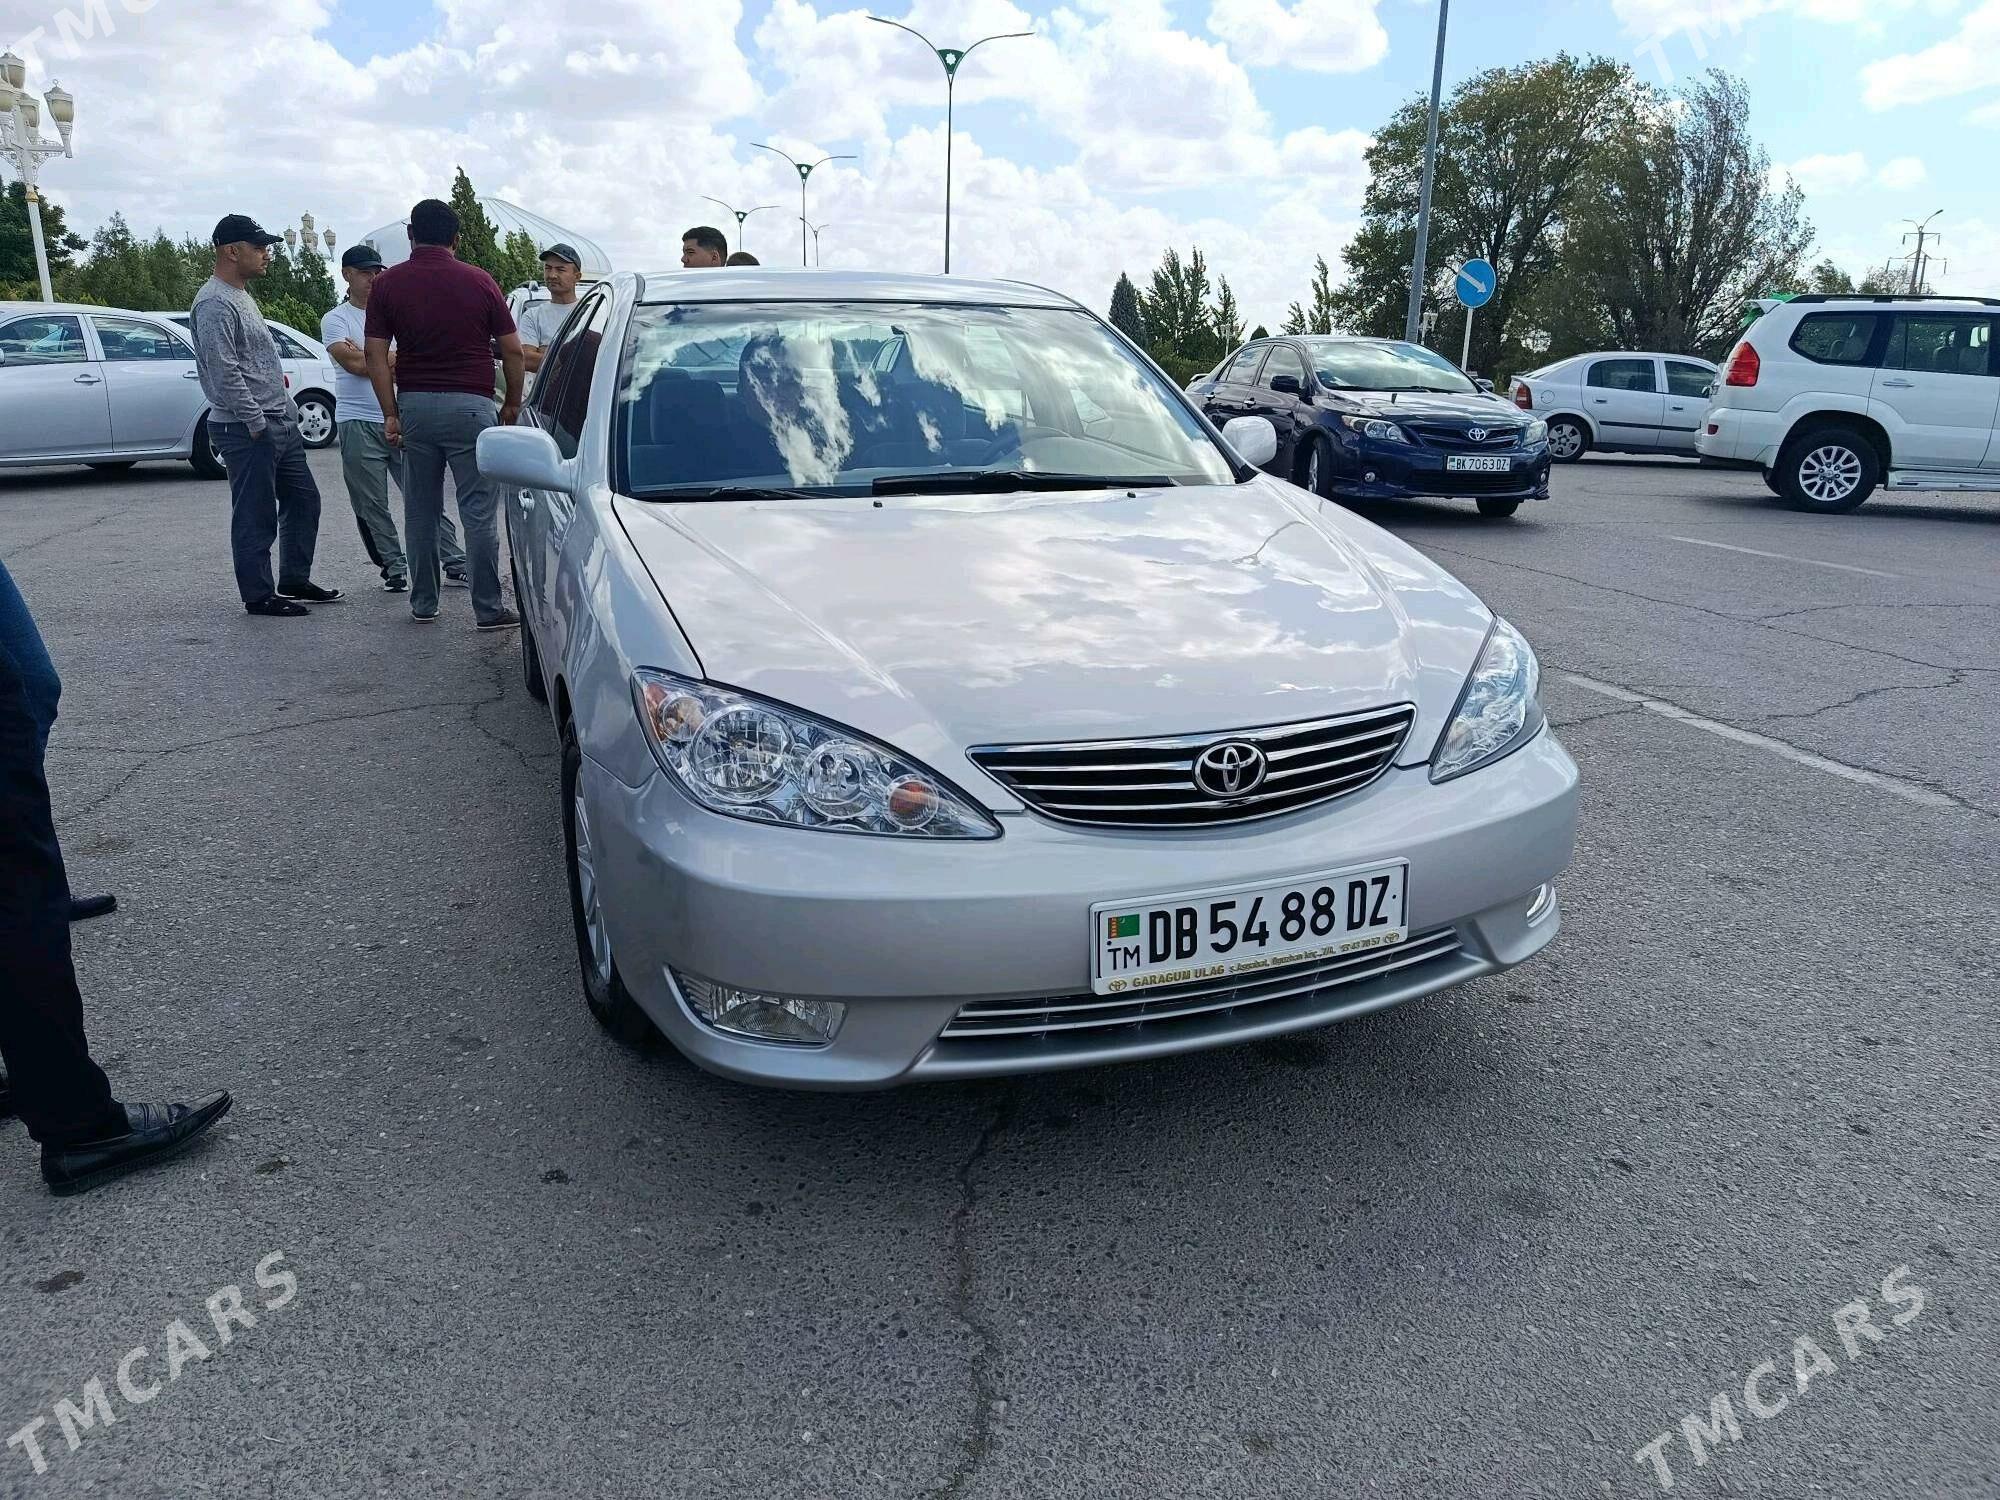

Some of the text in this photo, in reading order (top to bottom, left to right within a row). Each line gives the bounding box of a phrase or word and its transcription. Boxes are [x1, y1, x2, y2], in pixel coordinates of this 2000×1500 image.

[1456, 458, 1466, 470] BK
[1468, 458, 1495, 470] 7063
[1149, 907, 1198, 963] DB
[1347, 875, 1391, 931] DZ
[1107, 945, 1141, 971] TM
[1132, 970, 1191, 988] GARAGUM
[1195, 965, 1225, 979] ULAG
